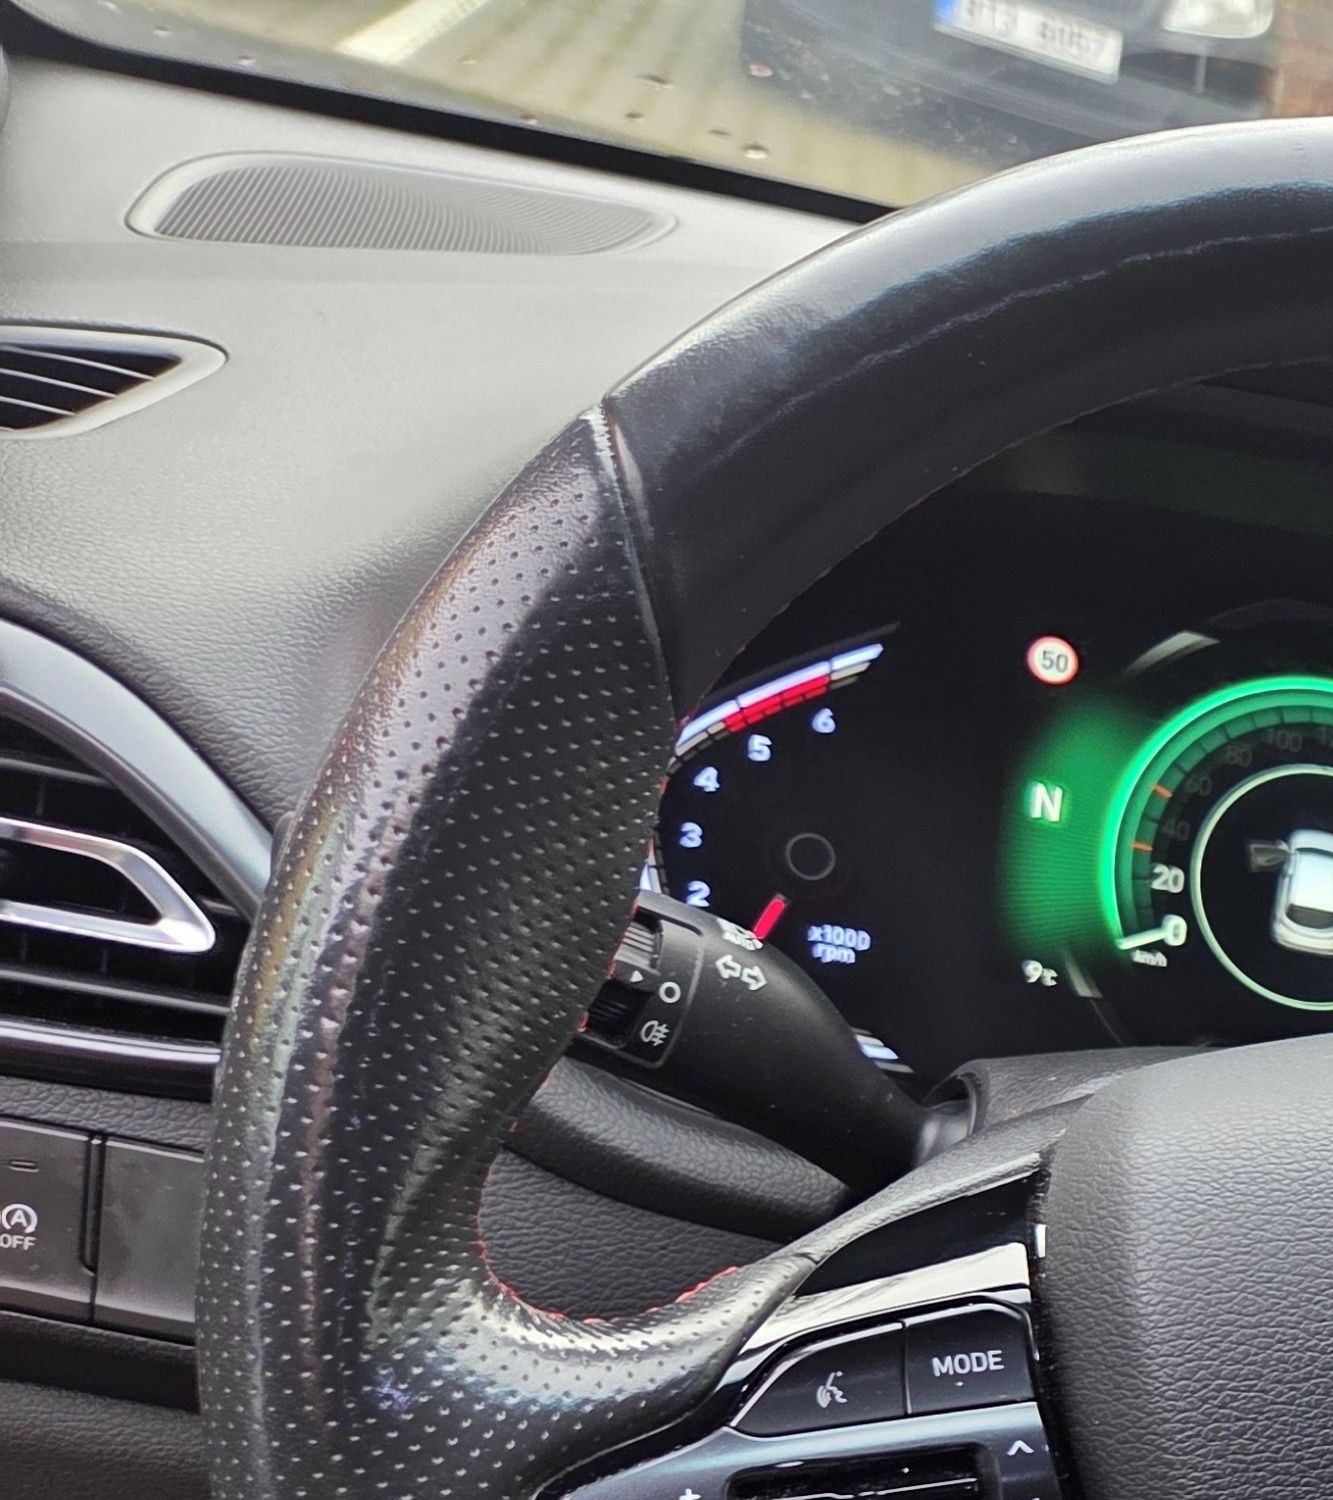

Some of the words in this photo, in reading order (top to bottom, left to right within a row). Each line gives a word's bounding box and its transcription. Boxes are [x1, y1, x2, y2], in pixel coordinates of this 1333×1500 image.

[1040, 649, 1070, 674] 50
[811, 708, 836, 733] 6
[748, 734, 772, 762] 5
[693, 766, 720, 792] 4
[1030, 782, 1063, 822] N
[679, 821, 703, 847] 3
[1152, 863, 1185, 893] 20
[687, 880, 711, 907] 2
[812, 943, 856, 964] rpm
[0, 1233, 36, 1250] OFF
[932, 1350, 1005, 1376] MODE
